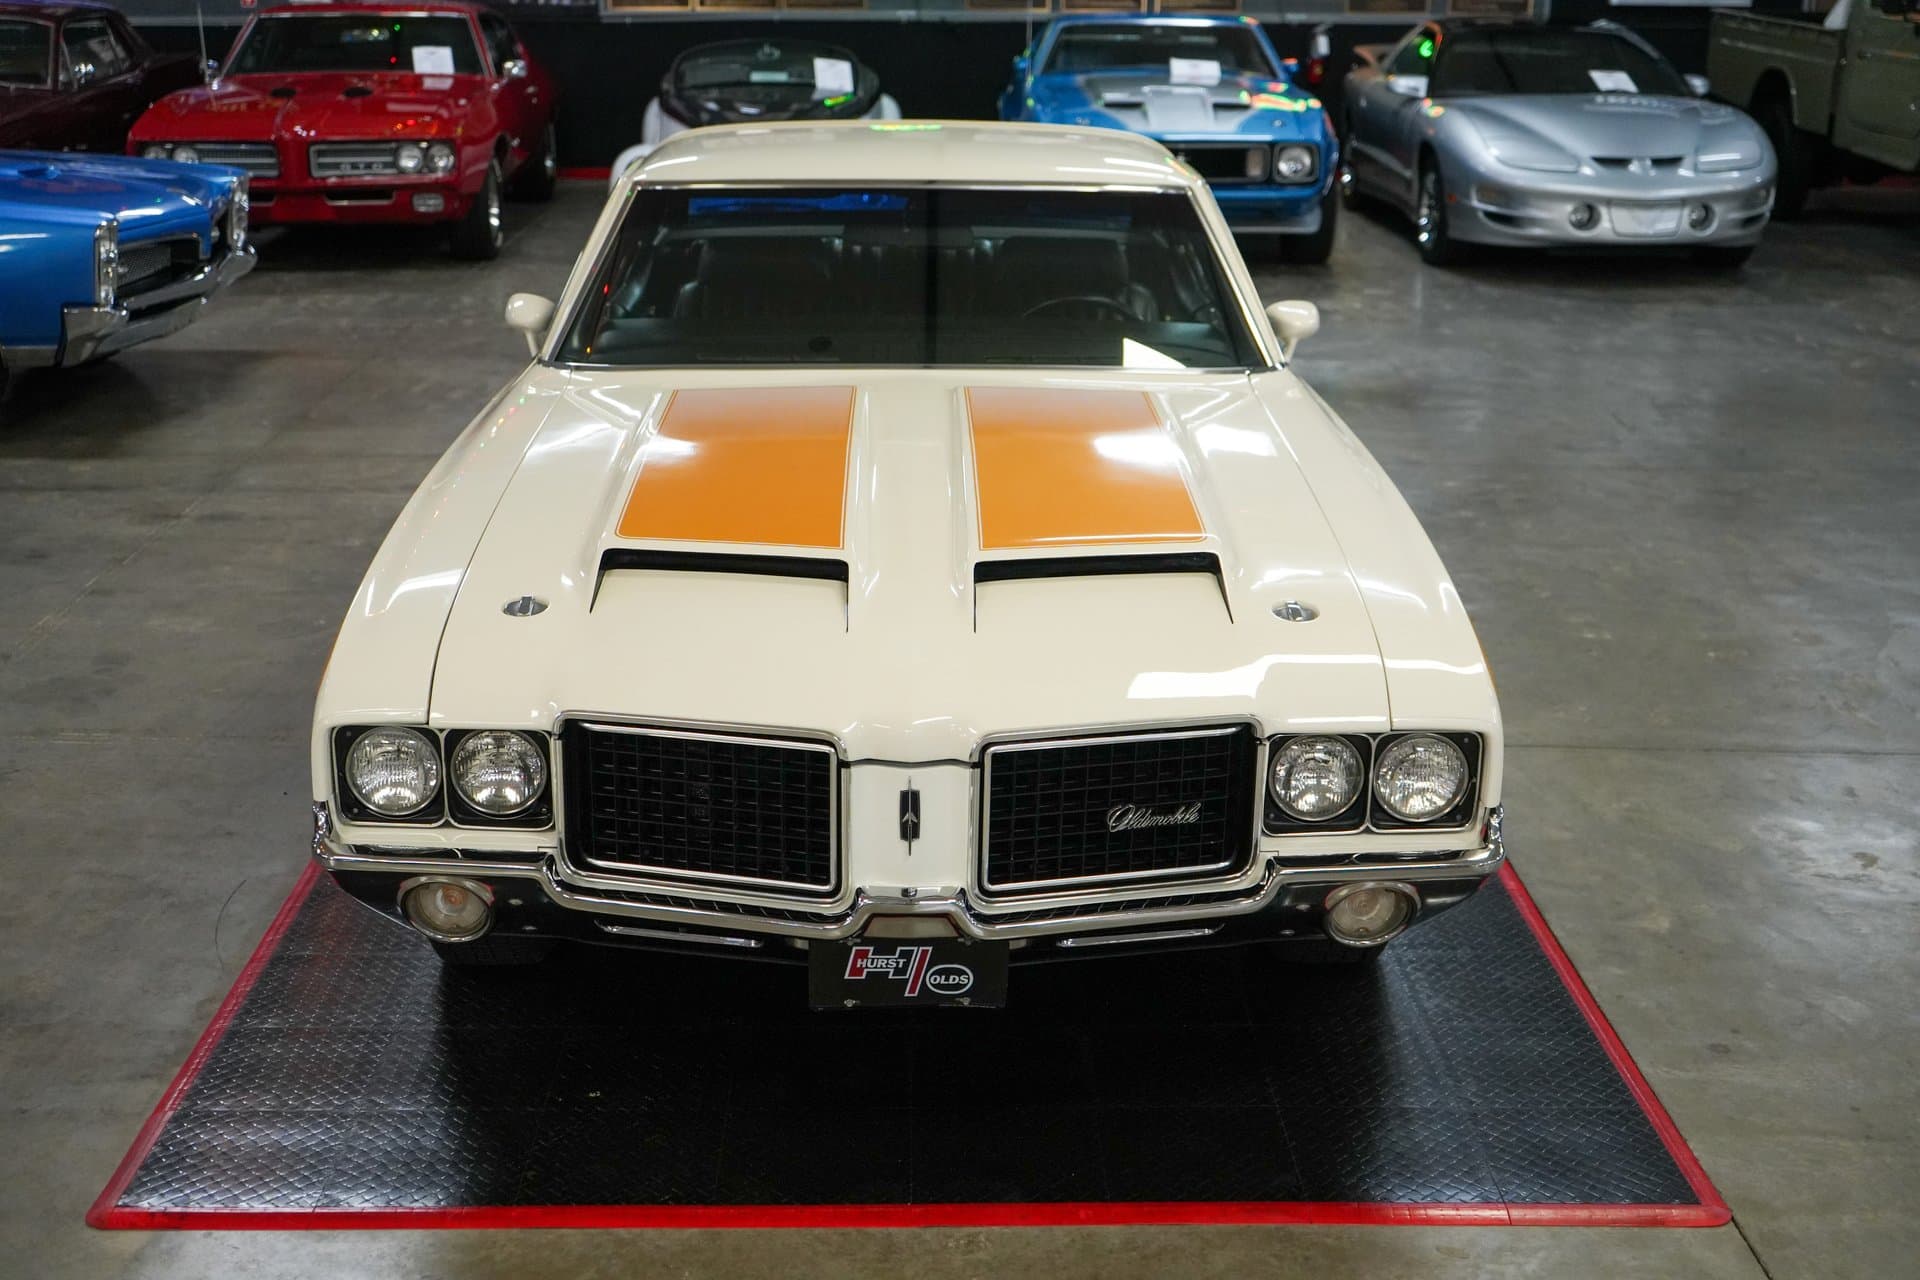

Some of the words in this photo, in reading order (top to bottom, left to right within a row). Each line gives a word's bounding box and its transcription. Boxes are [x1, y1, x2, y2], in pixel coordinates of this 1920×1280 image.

[1107, 802, 1201, 832] Oldsmobile
[856, 958, 906, 968] HURST
[930, 975, 969, 984] OLDS
